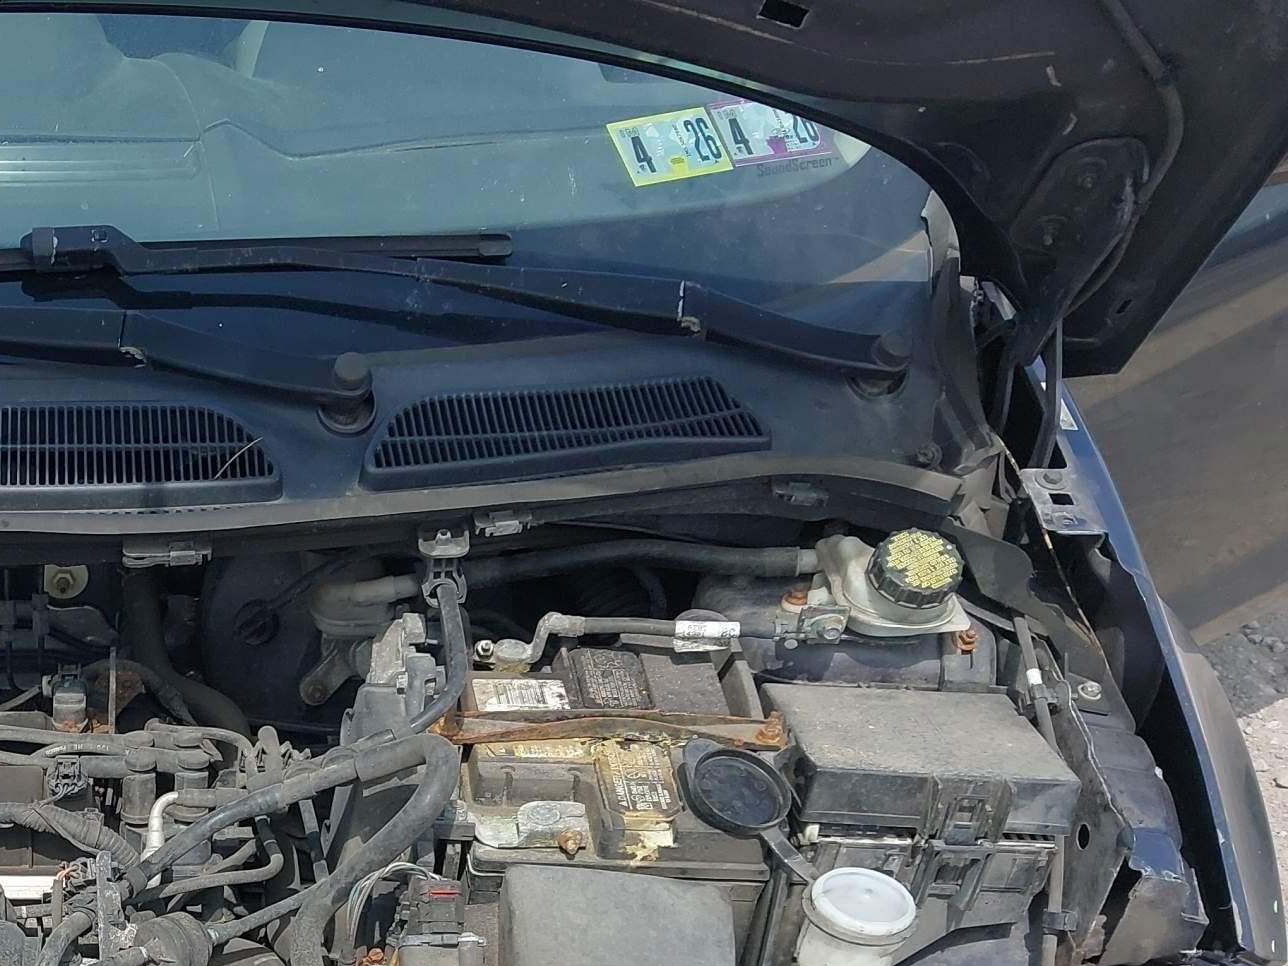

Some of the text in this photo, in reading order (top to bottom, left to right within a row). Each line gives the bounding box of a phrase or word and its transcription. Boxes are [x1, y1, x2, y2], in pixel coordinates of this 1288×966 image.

[631, 135, 657, 173] 4
[683, 117, 722, 162] 26
[728, 117, 754, 155] 4
